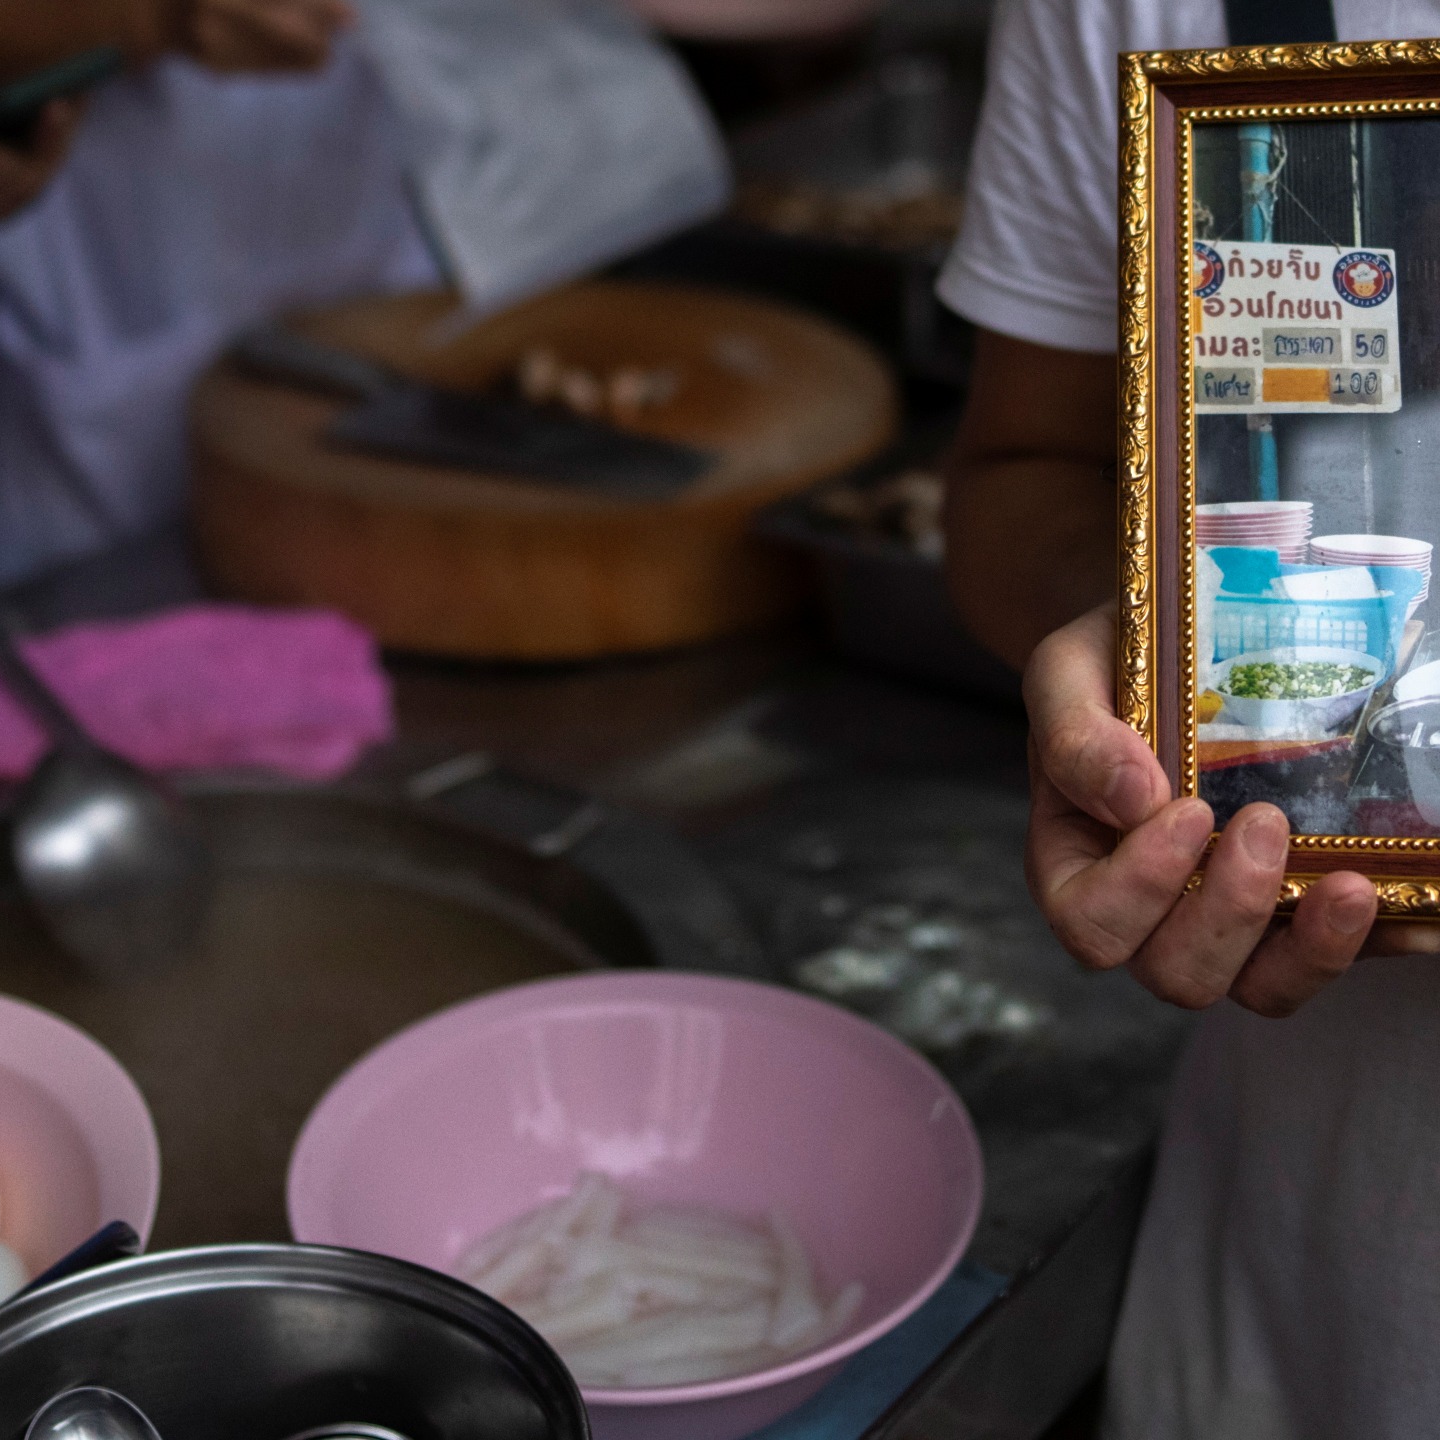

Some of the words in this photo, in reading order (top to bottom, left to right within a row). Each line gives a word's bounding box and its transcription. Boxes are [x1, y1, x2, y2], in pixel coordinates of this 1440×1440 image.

[1195, 336, 1261, 357] ามละ
[1355, 334, 1386, 358] 50
[1333, 371, 1378, 395] 100
